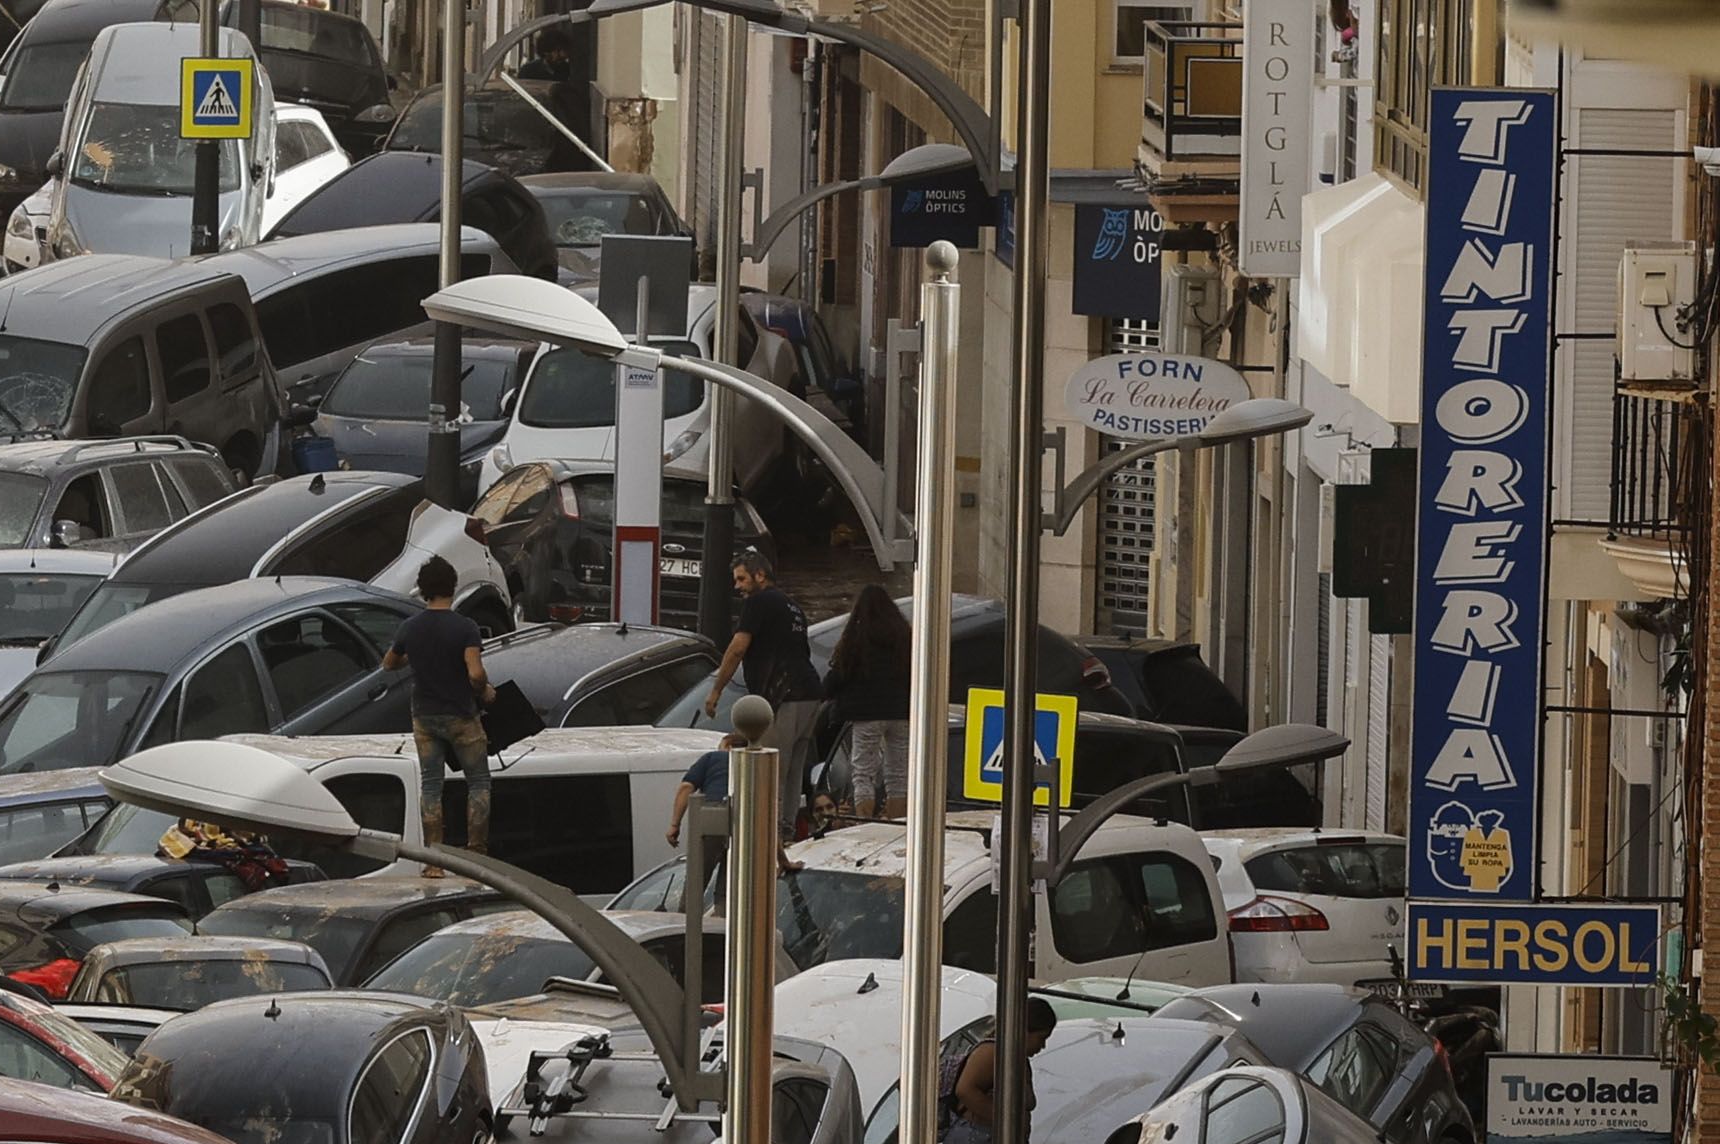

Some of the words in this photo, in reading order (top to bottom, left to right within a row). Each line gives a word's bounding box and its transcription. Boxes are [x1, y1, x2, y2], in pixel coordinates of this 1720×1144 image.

[1265, 22, 1289, 220] ROTGLÁ
[925, 190, 966, 200] MOLINS
[1249, 239, 1302, 255] JEWELS
[1118, 359, 1203, 382] FORN
[1079, 377, 1115, 406] La
[1126, 380, 1230, 412] Carretera
[1424, 100, 1535, 792] TINTORERIA
[1416, 918, 1650, 973] HERSOL
[1501, 1075, 1658, 1104] Tucolada
[1573, 1119, 1597, 1127] AUTO
[1606, 1119, 1649, 1128] SERVICIO
[1591, 1108, 1638, 1116] SECAR
